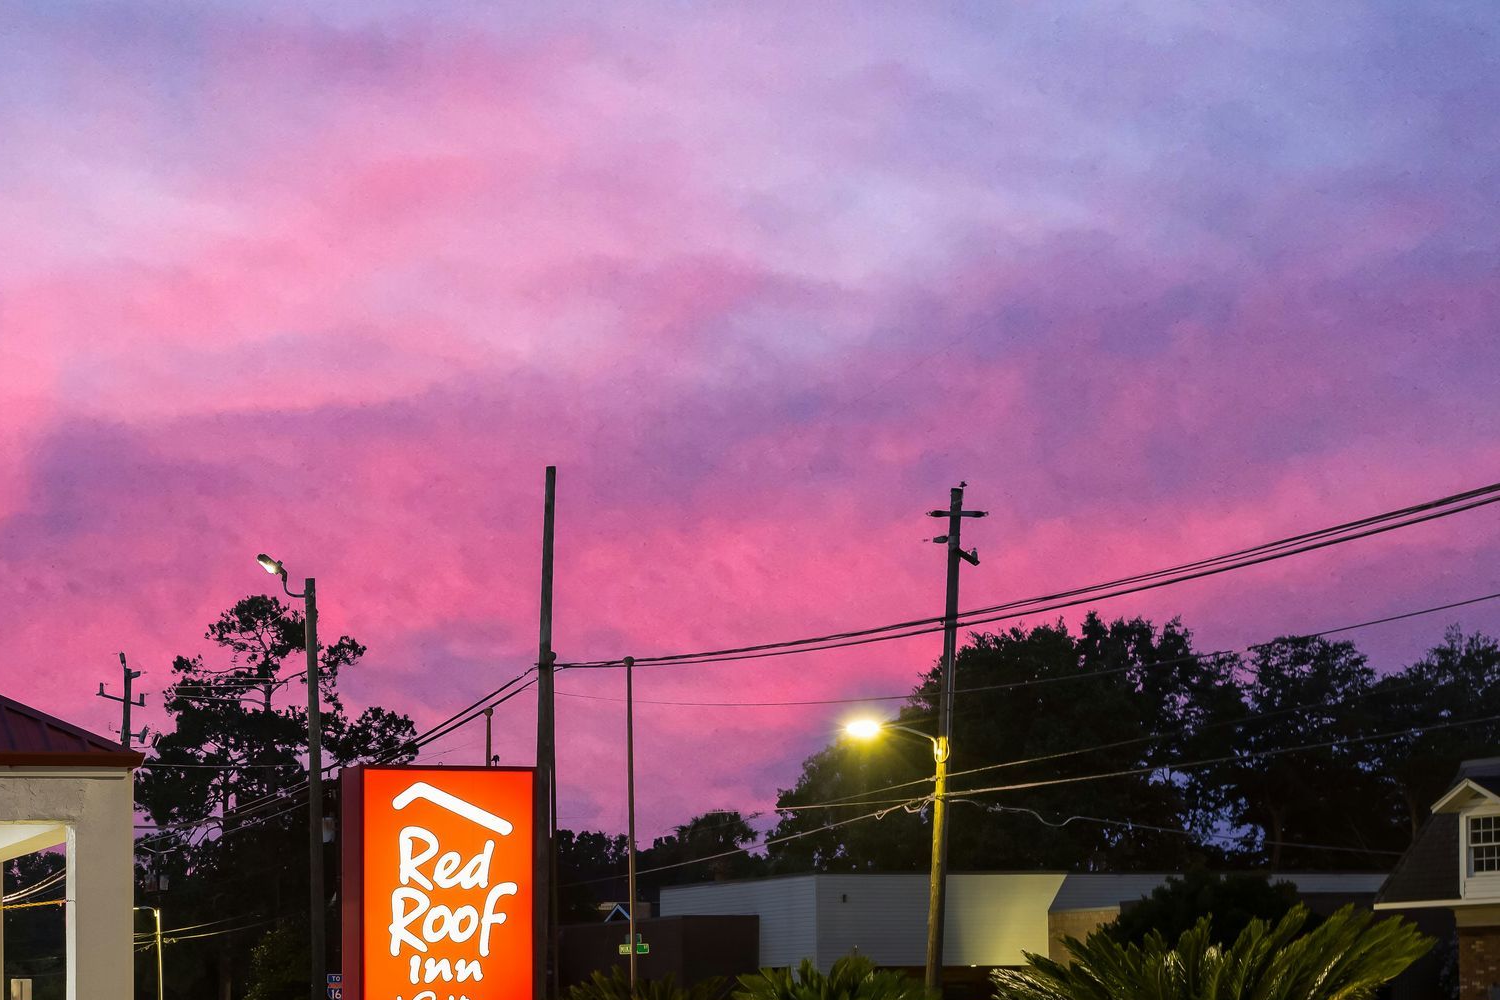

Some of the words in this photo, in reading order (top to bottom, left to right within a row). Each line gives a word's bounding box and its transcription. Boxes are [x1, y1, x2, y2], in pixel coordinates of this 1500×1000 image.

[399, 825, 495, 891] Red
[388, 881, 518, 957] Roof
[331, 989, 342, 1000] 16
